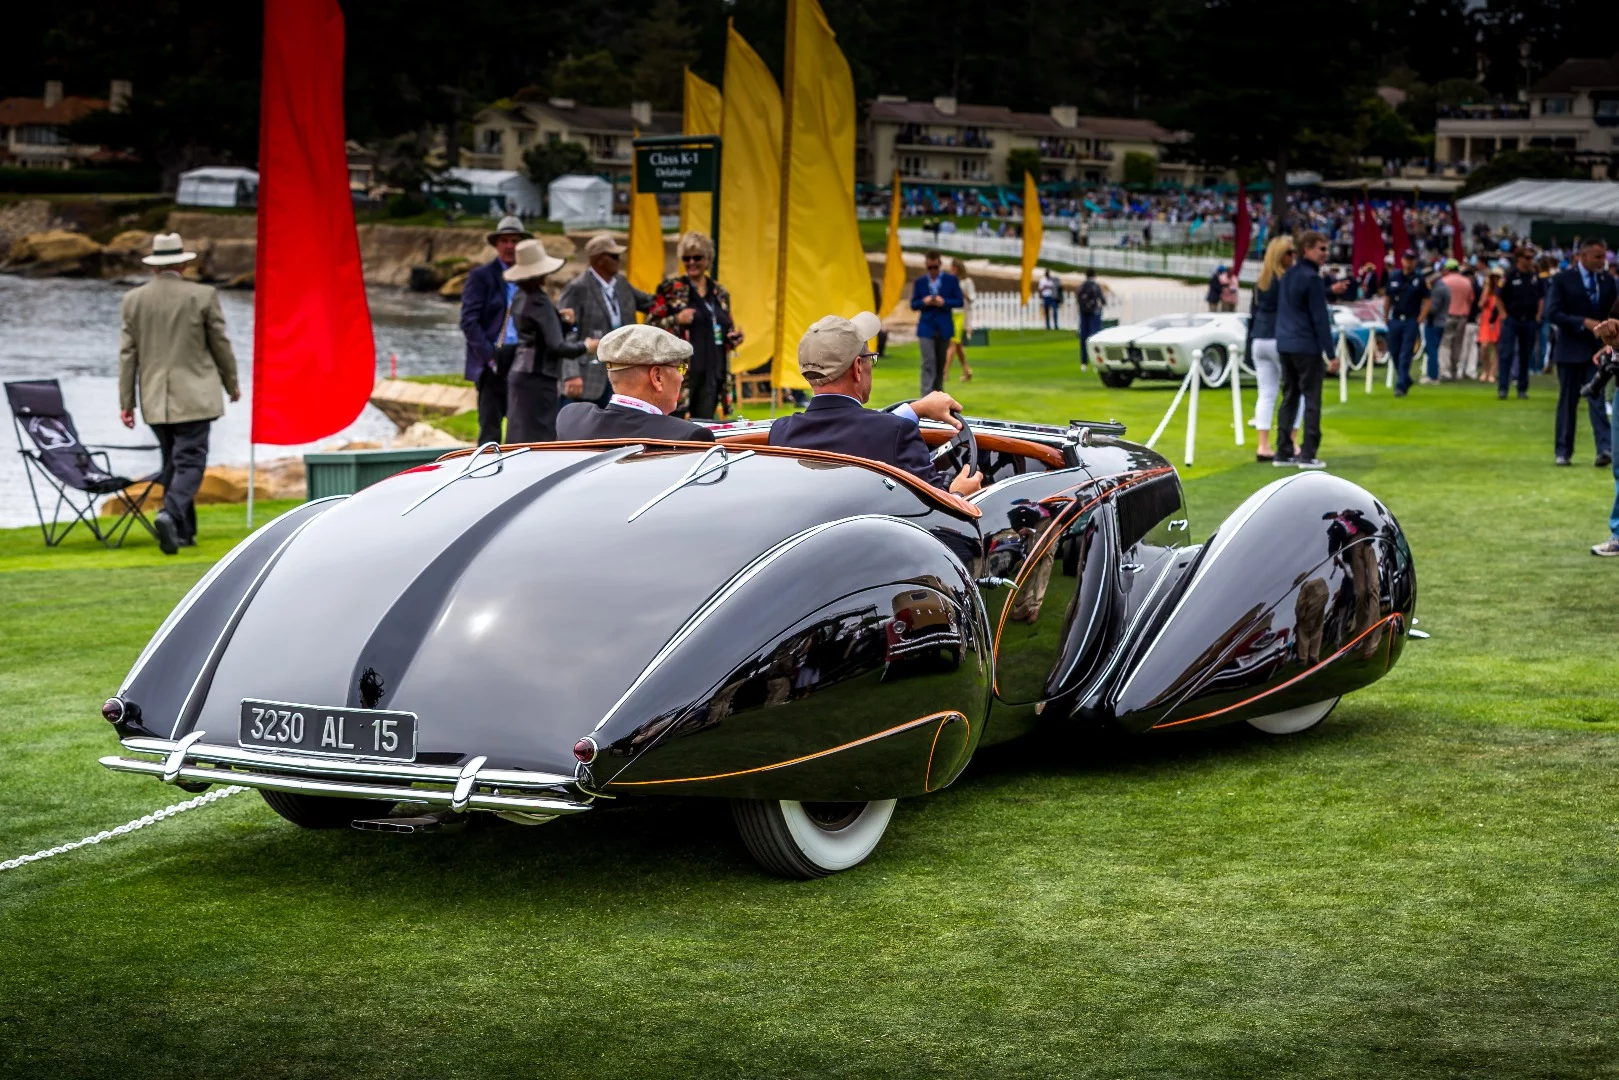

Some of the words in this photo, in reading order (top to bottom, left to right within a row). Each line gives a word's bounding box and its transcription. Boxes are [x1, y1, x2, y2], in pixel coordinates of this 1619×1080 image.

[649, 152, 679, 166] Class
[681, 152, 698, 165] K-1
[251, 707, 304, 743] 3230
[321, 716, 354, 749] AL
[371, 719, 398, 751] 15
